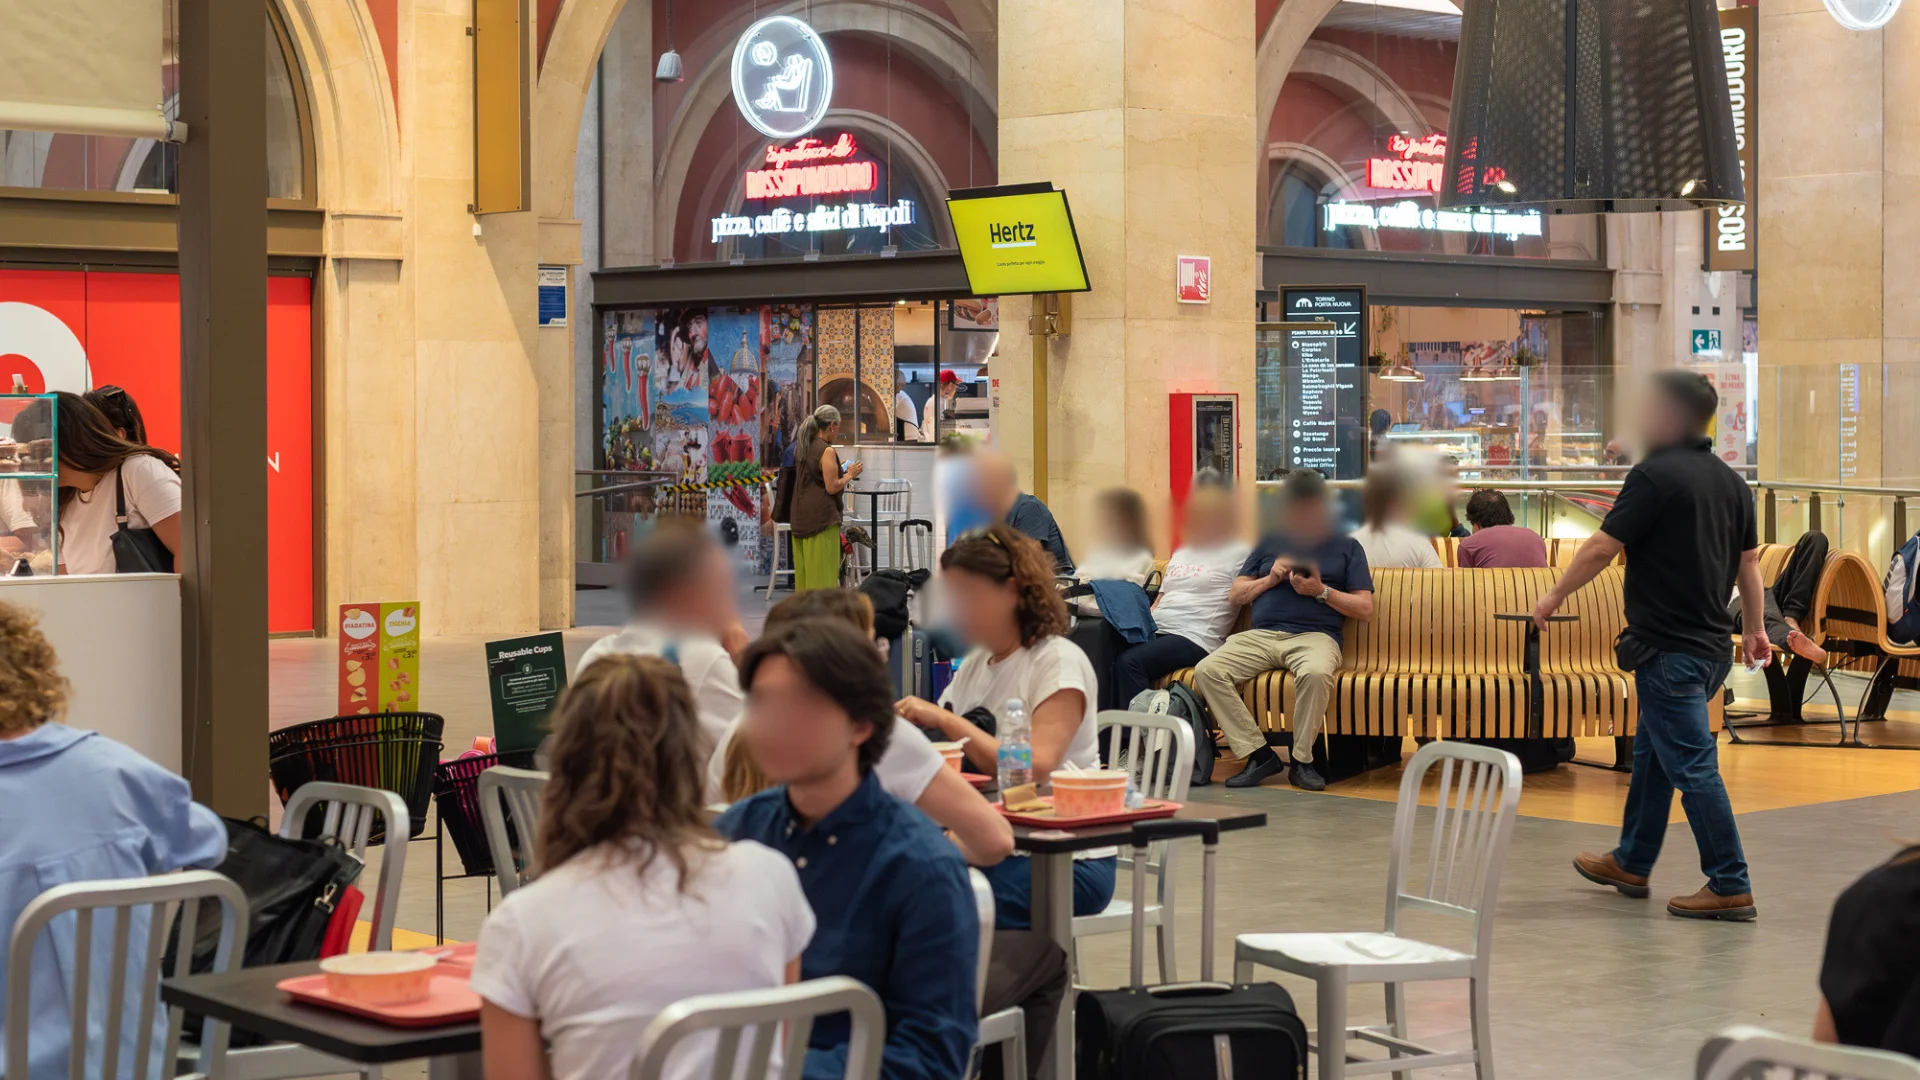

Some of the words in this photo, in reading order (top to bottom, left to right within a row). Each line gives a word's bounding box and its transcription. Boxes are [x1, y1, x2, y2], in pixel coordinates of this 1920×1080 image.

[1717, 27, 1746, 251] ROSODORO
[745, 161, 878, 199] ROSSOPOMODORO
[862, 199, 915, 233] Napoli
[989, 221, 1036, 242] Hertz
[498, 647, 533, 659] Reusable
[533, 645, 553, 654] Cups
